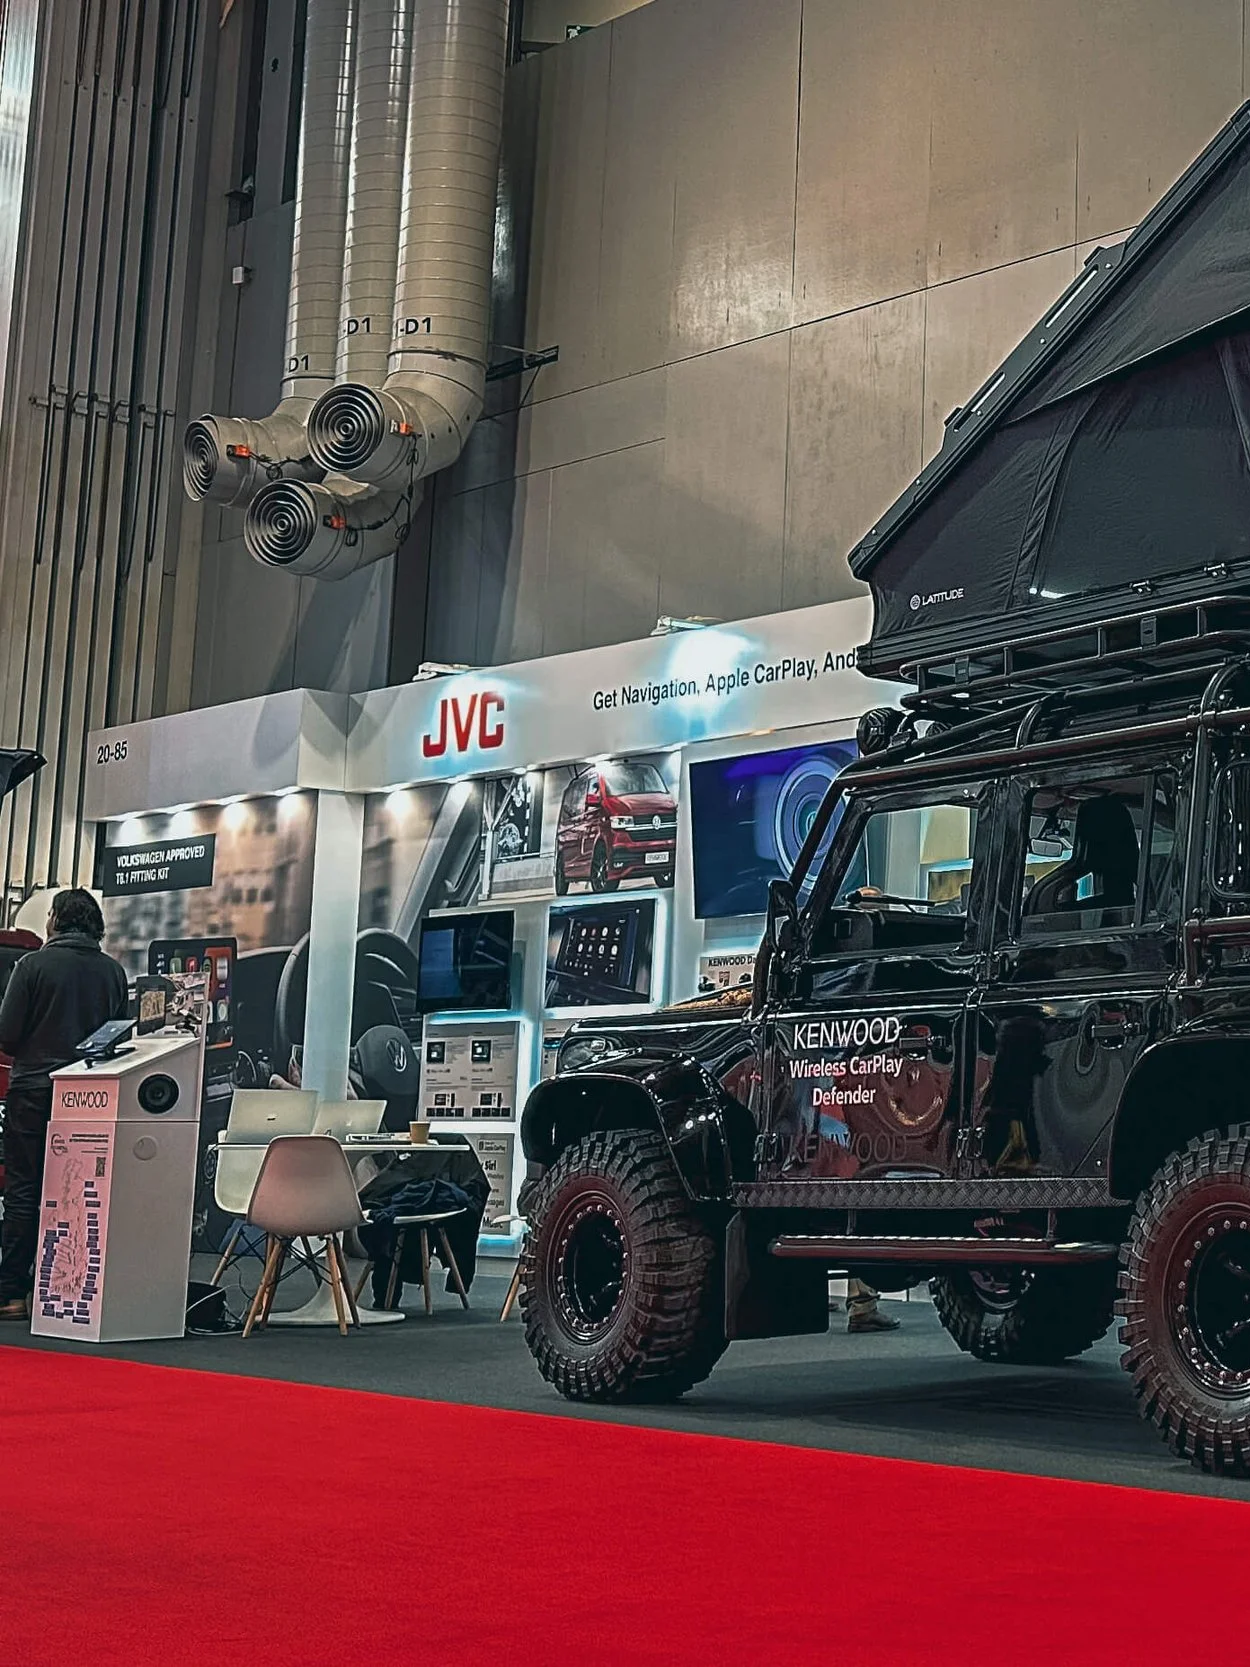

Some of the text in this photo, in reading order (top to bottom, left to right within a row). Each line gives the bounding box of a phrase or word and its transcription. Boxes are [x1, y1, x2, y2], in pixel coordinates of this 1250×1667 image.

[922, 588, 964, 606] LATITUDE
[593, 690, 618, 710] Get
[621, 679, 701, 706] Navigation,
[705, 667, 749, 696] Apple
[754, 658, 818, 685] CarPlay,
[423, 690, 505, 758] JVC
[97, 740, 127, 764] 20-85
[117, 845, 205, 868] VOLKSWAGEN APPROVED
[130, 869, 156, 883] FITTING
[157, 867, 170, 880] KIT
[709, 956, 746, 966] KENWOOD
[793, 1017, 900, 1050] KENWOOD
[789, 1054, 904, 1079] Wireless CarPlay
[61, 1091, 109, 1108] KENWOOD
[812, 1085, 876, 1106] Defender
